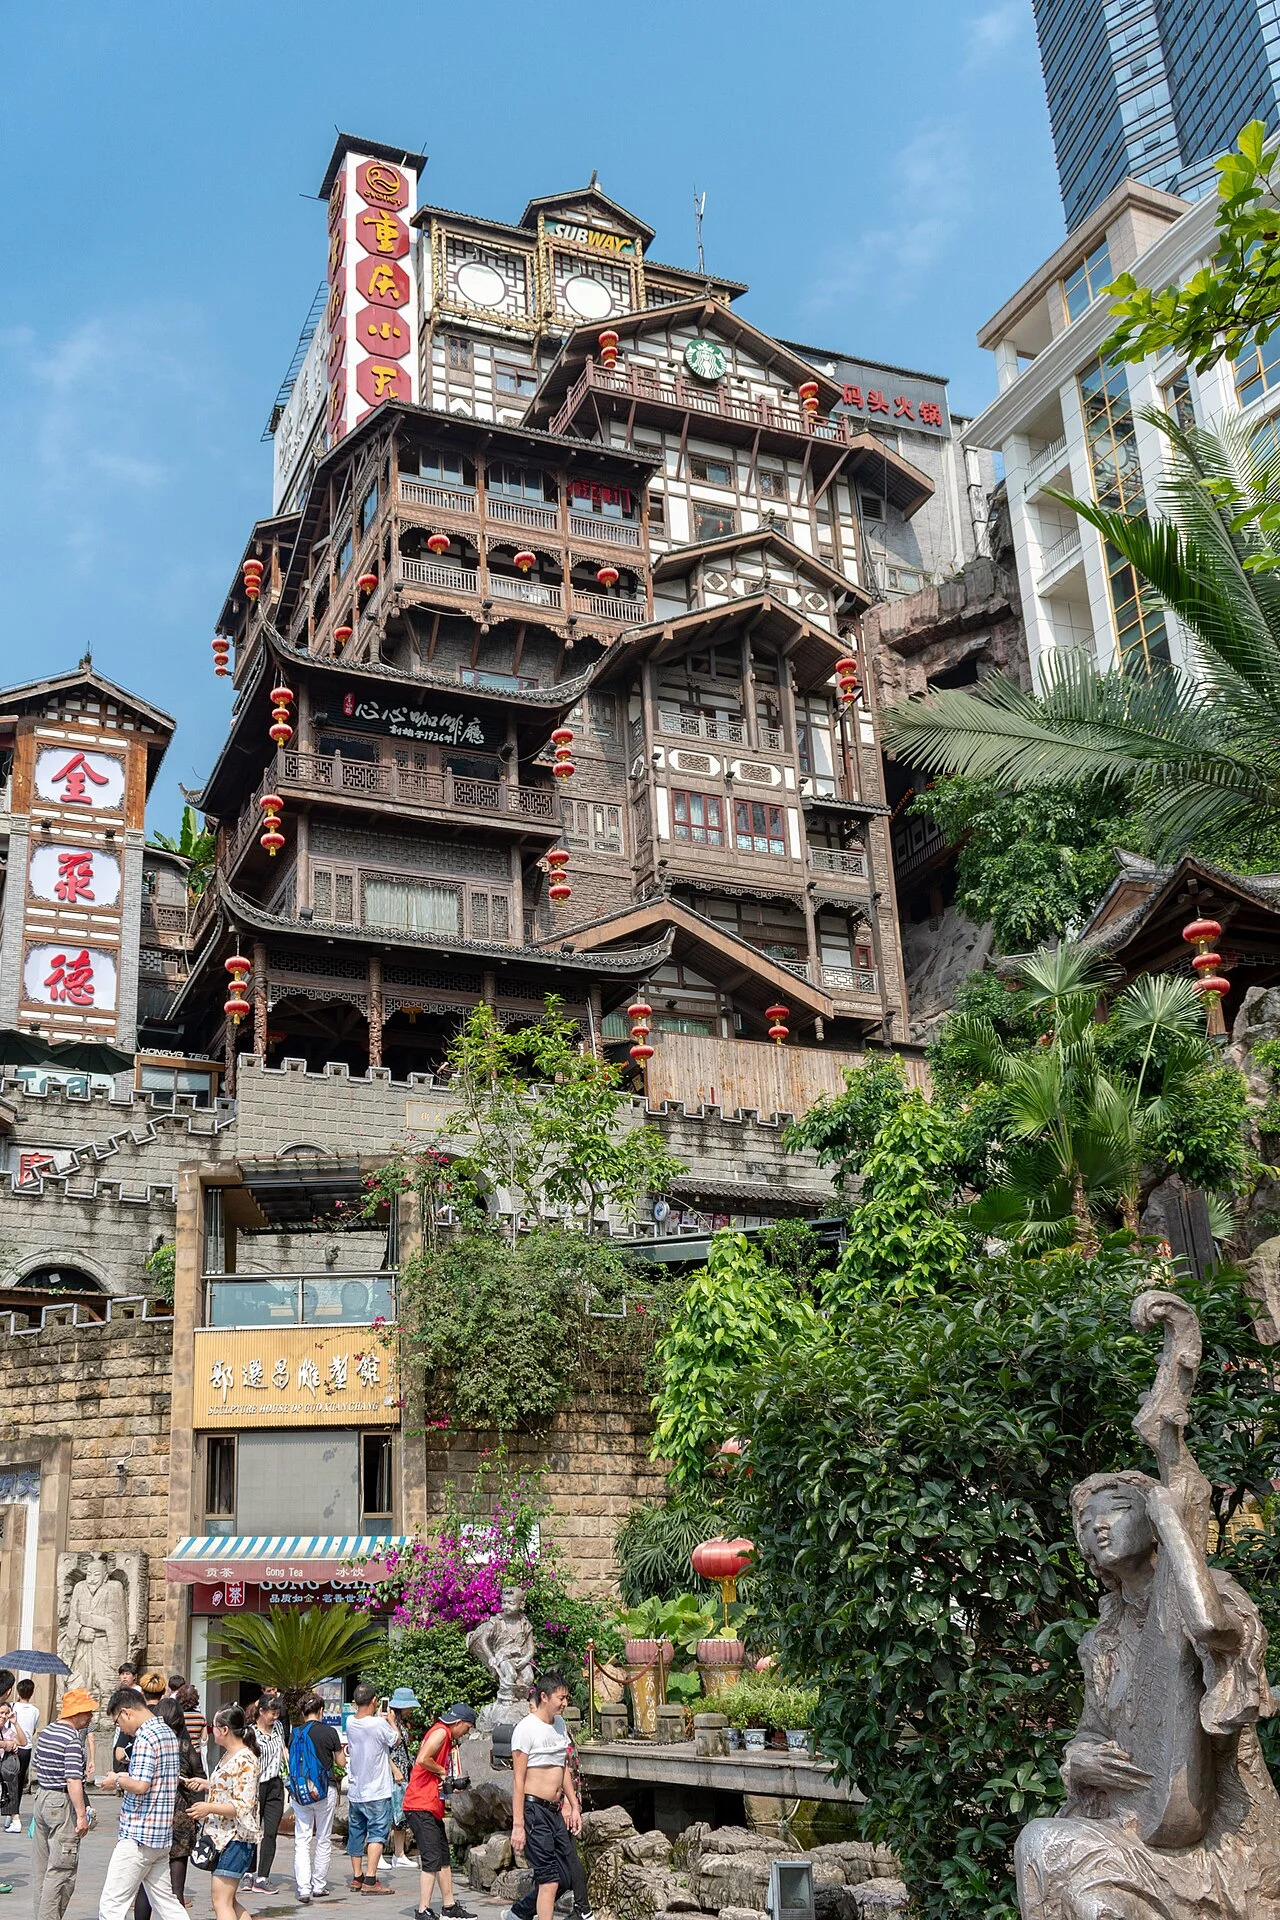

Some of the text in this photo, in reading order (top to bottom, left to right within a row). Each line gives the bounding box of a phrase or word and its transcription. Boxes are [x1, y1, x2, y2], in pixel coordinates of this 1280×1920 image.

[550, 223, 632, 253] SUBWAY
[841, 384, 943, 427] 码头火锅
[207, 1405, 257, 1415] SCULPTURE
[259, 1404, 289, 1414] HOUSE
[291, 1403, 303, 1413] OF
[205, 1567, 235, 1578] 贡茶
[265, 1567, 304, 1577] Gong Tea
[335, 1567, 365, 1578] 冰饮
